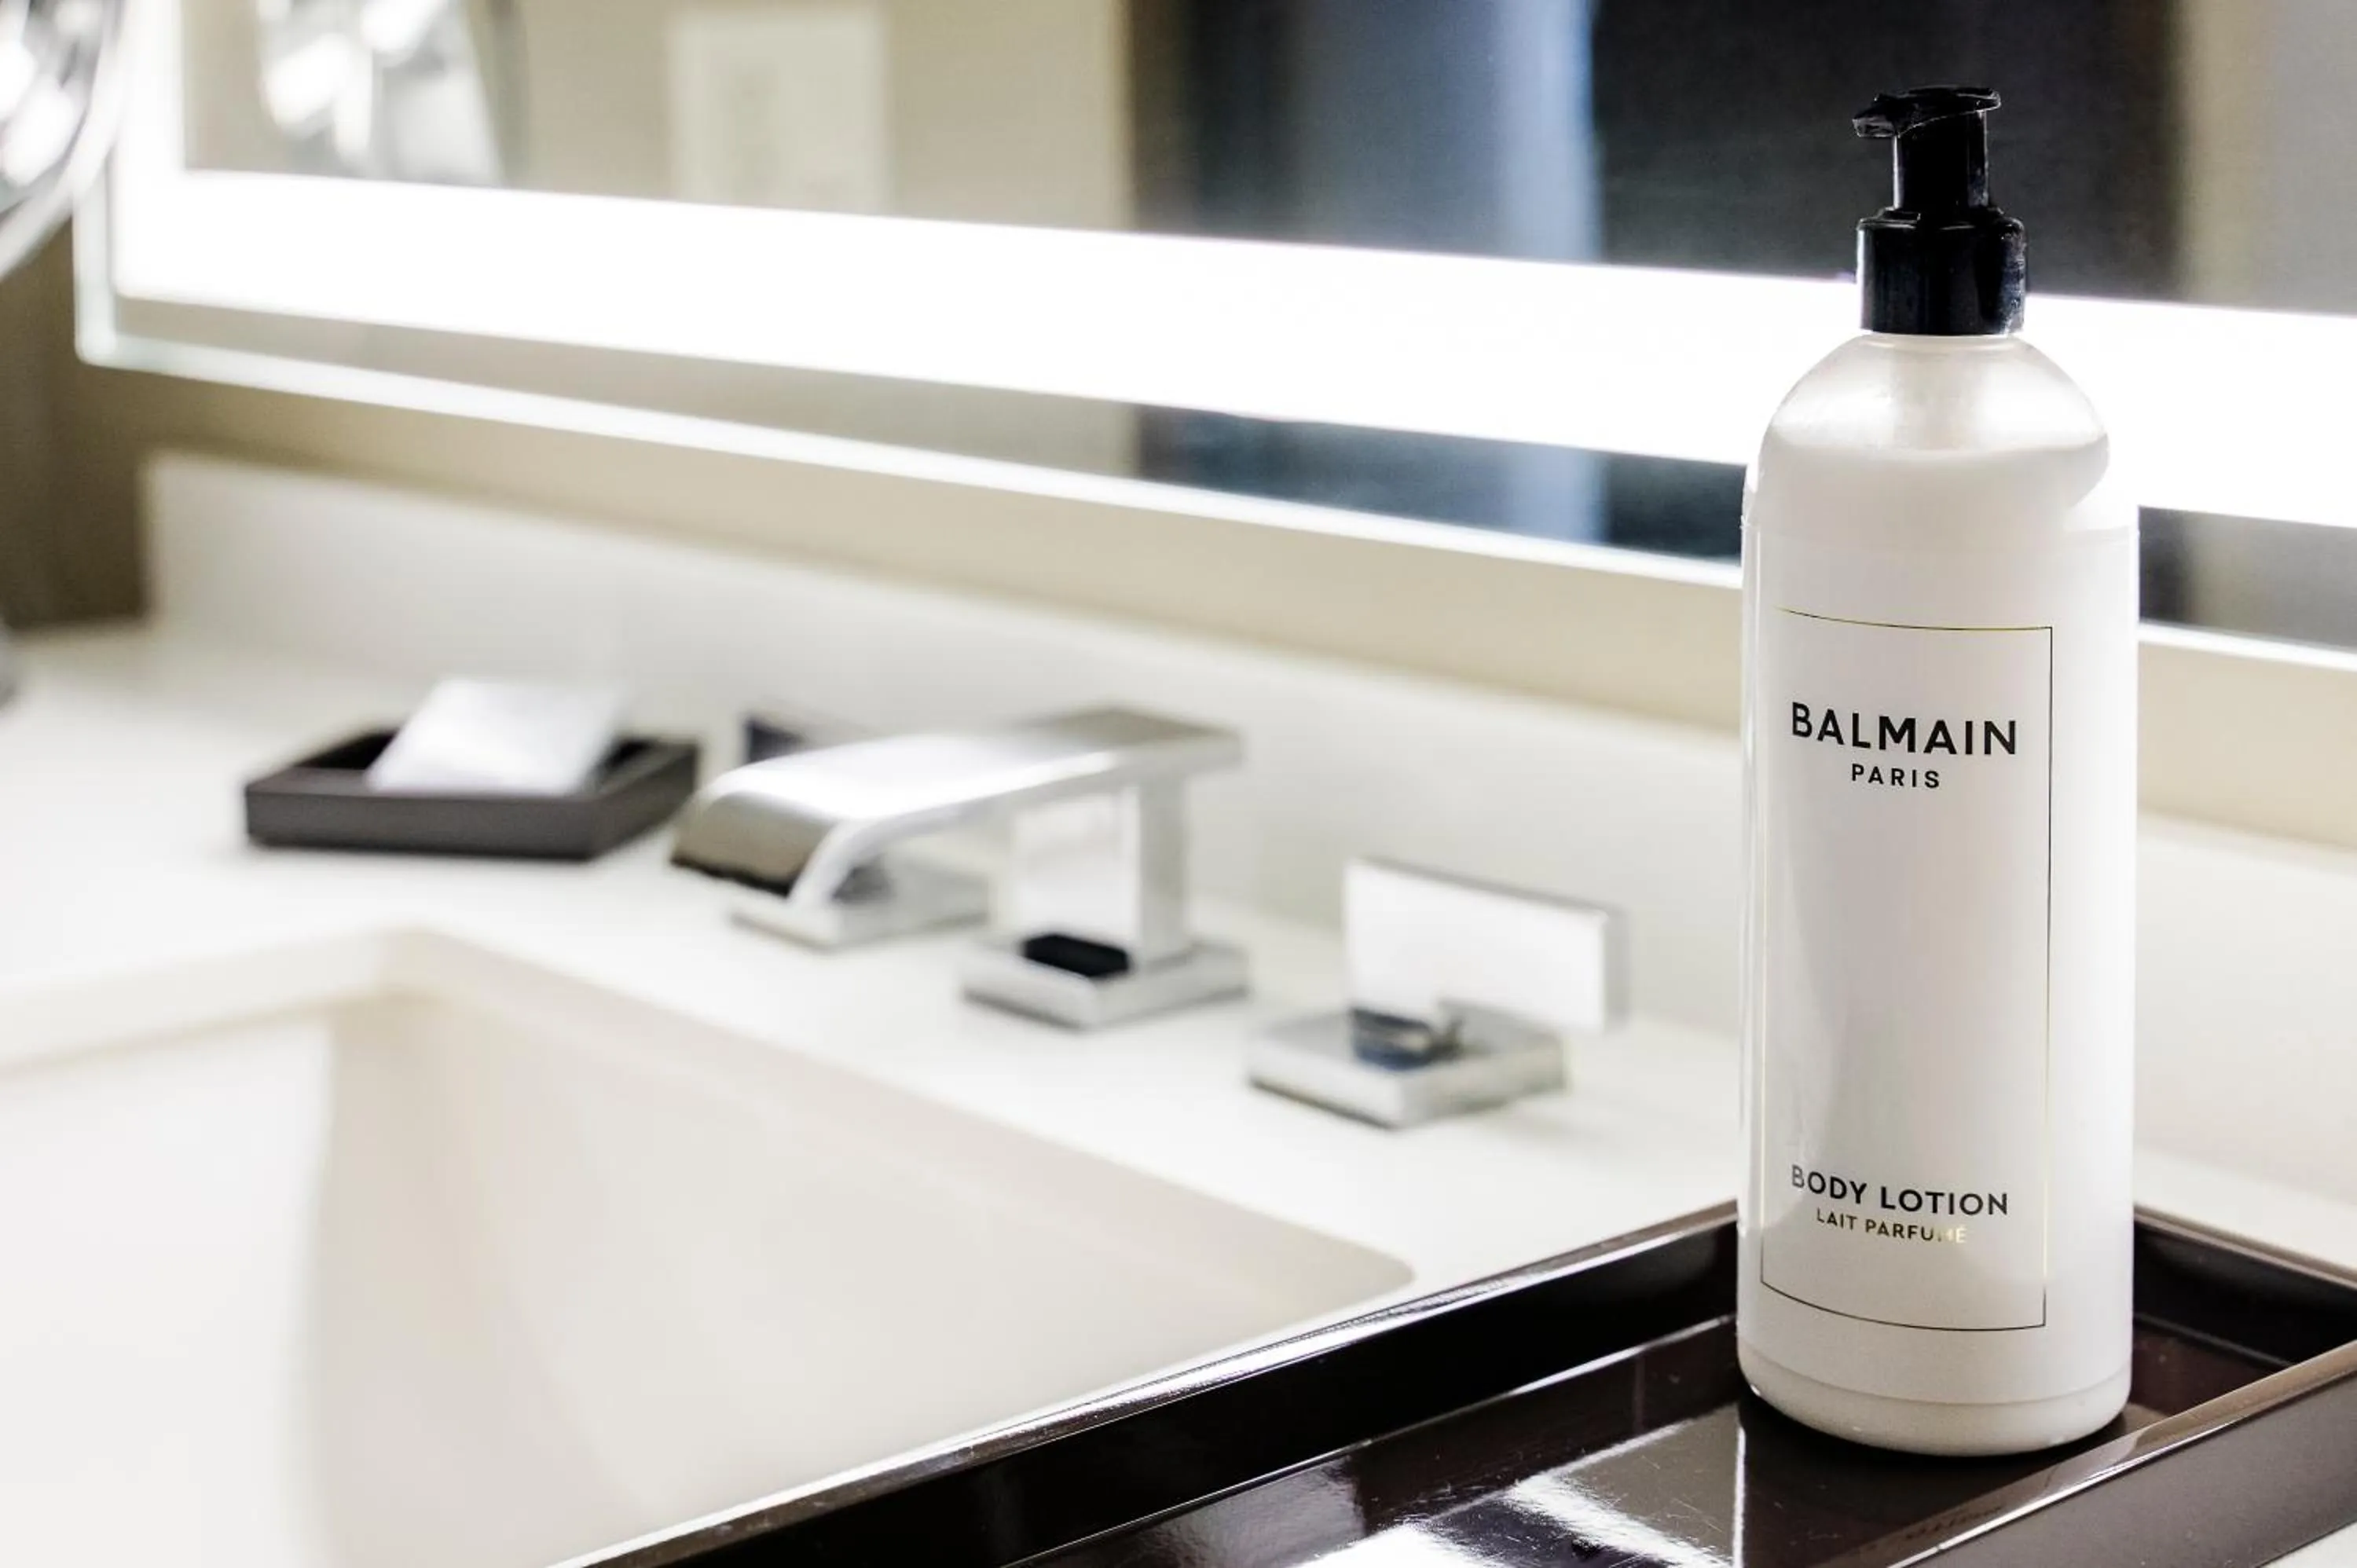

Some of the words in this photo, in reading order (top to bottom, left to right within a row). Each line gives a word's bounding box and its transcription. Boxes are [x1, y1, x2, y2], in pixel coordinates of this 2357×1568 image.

[1791, 702, 2016, 756] BALMAIN
[1851, 763, 1940, 789] PARIS
[1791, 1164, 1868, 1204] BODY
[1880, 1186, 2008, 1216] LOTION
[1816, 1207, 1858, 1231] LAIT
